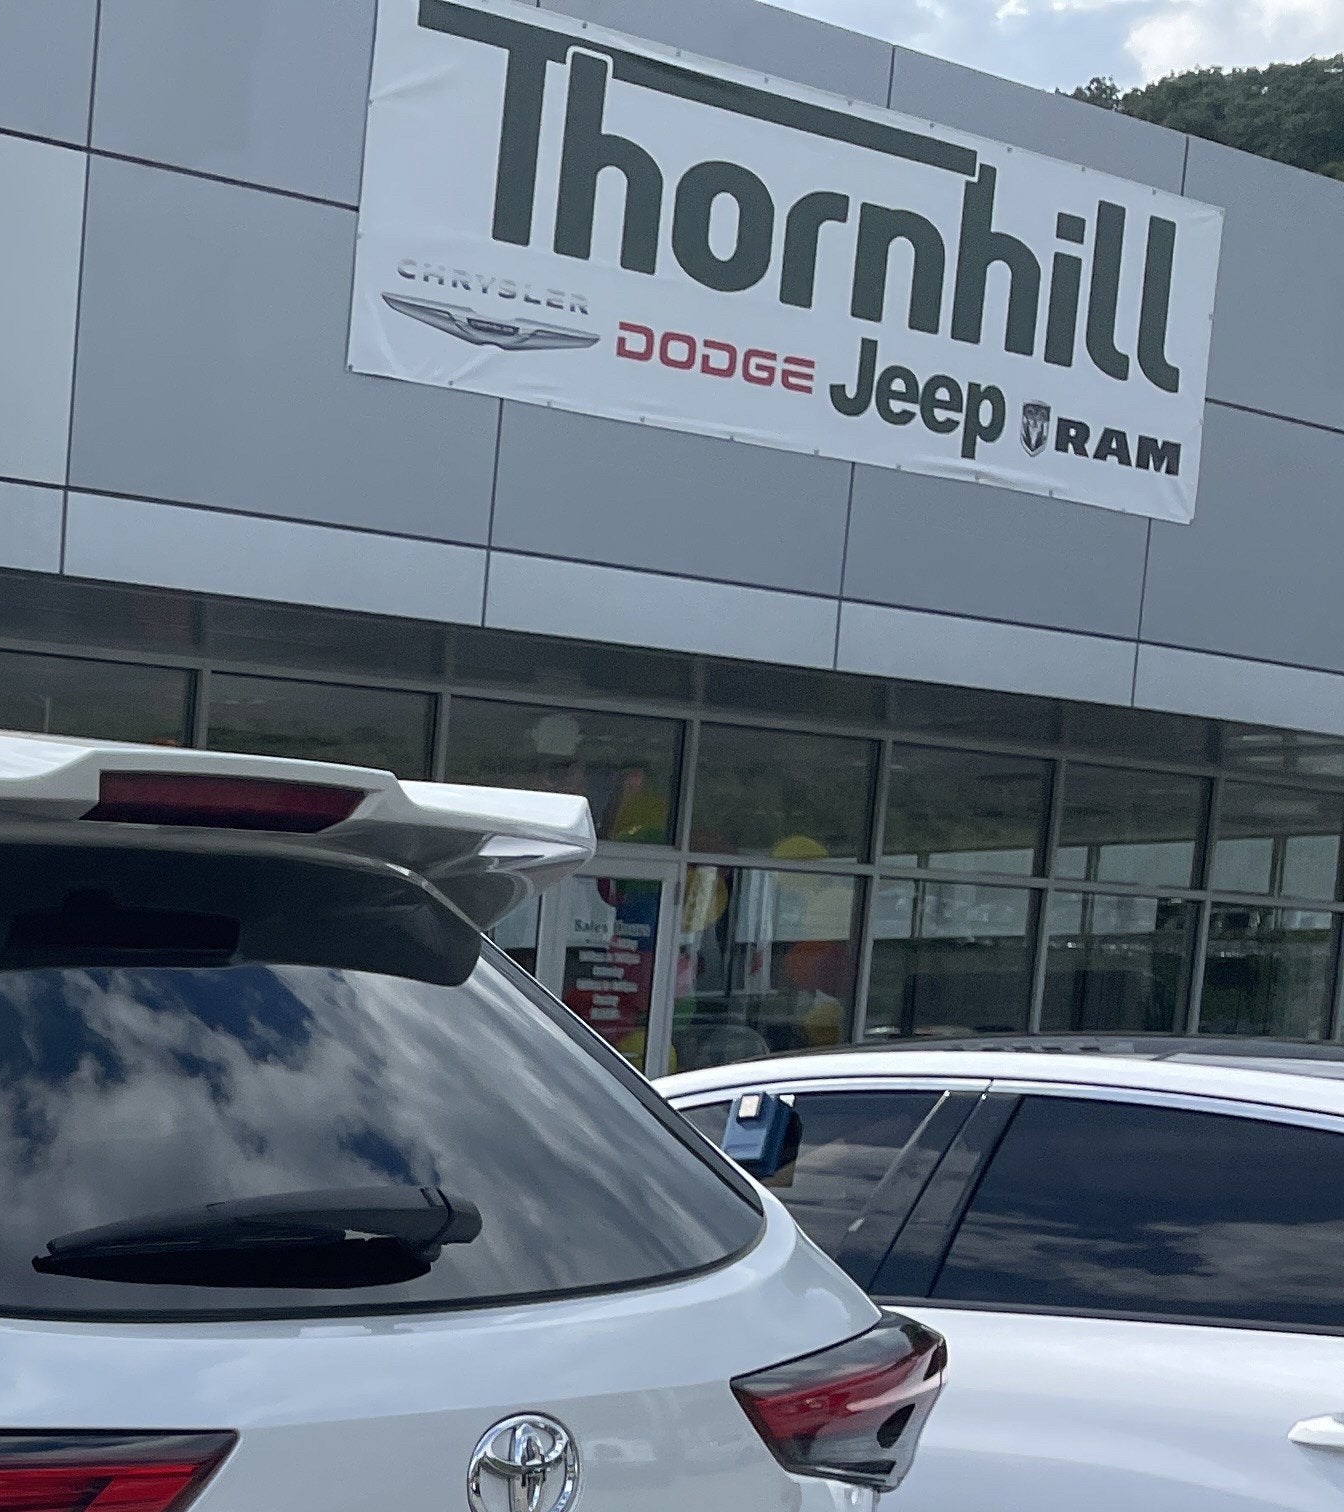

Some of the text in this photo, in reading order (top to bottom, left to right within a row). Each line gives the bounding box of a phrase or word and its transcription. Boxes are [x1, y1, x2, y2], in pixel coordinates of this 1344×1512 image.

[416, 0, 1181, 394] Thornhill
[397, 258, 589, 315] CHRYSLER
[615, 321, 1182, 477] DODGE Jeep RAM
